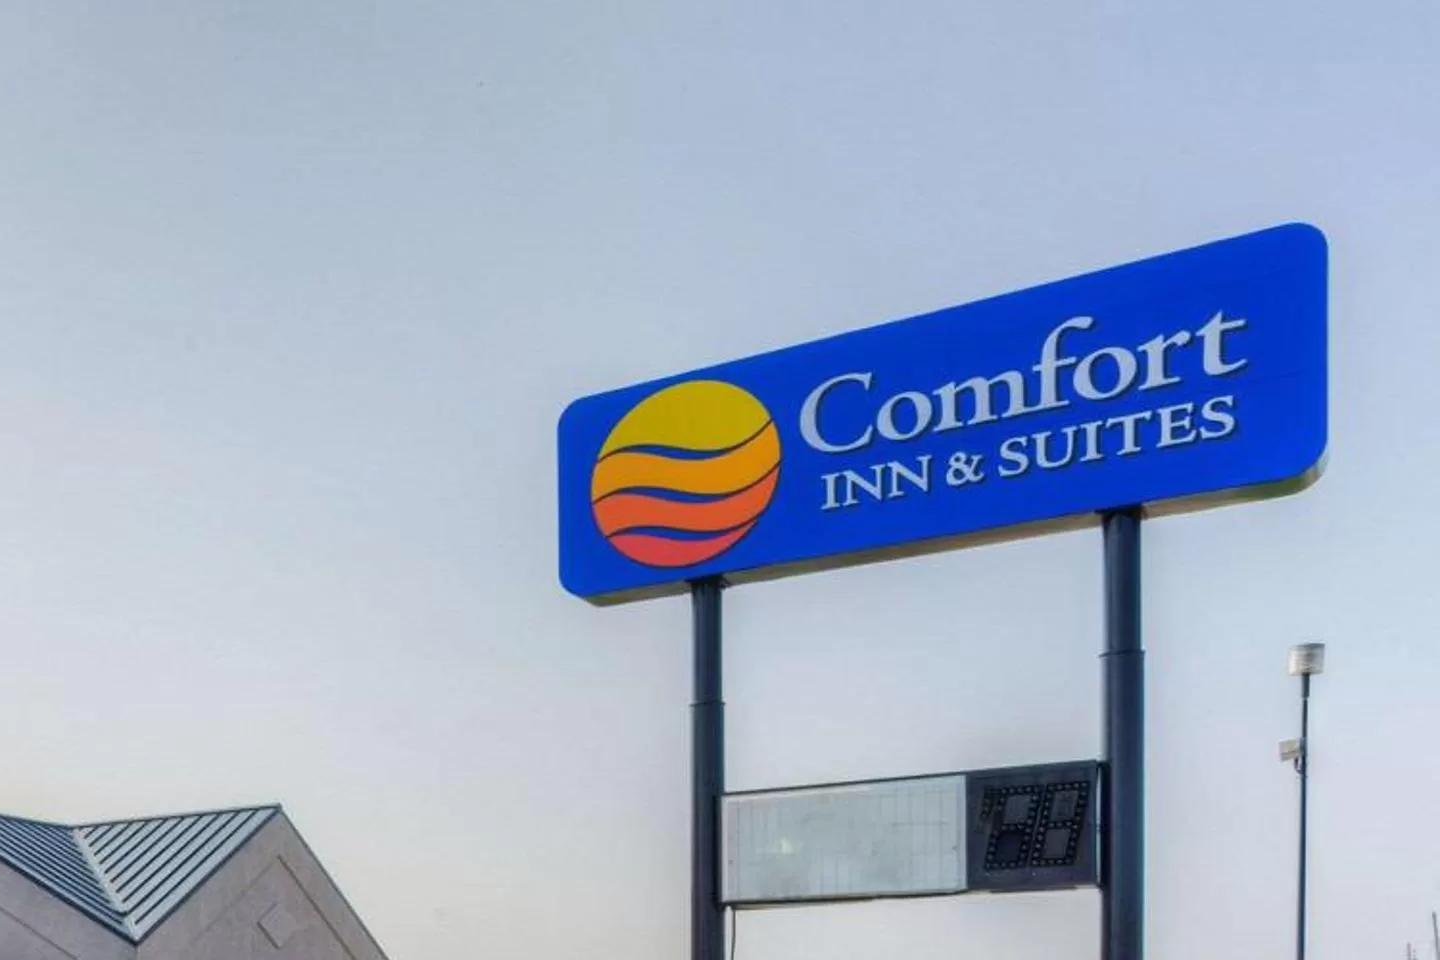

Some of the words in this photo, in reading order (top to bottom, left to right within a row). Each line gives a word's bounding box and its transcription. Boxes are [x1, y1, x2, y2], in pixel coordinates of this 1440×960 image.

[799, 310, 1248, 453] Comfort
[821, 455, 932, 510] INN
[946, 452, 985, 486] &
[998, 395, 1236, 477] SUITES
